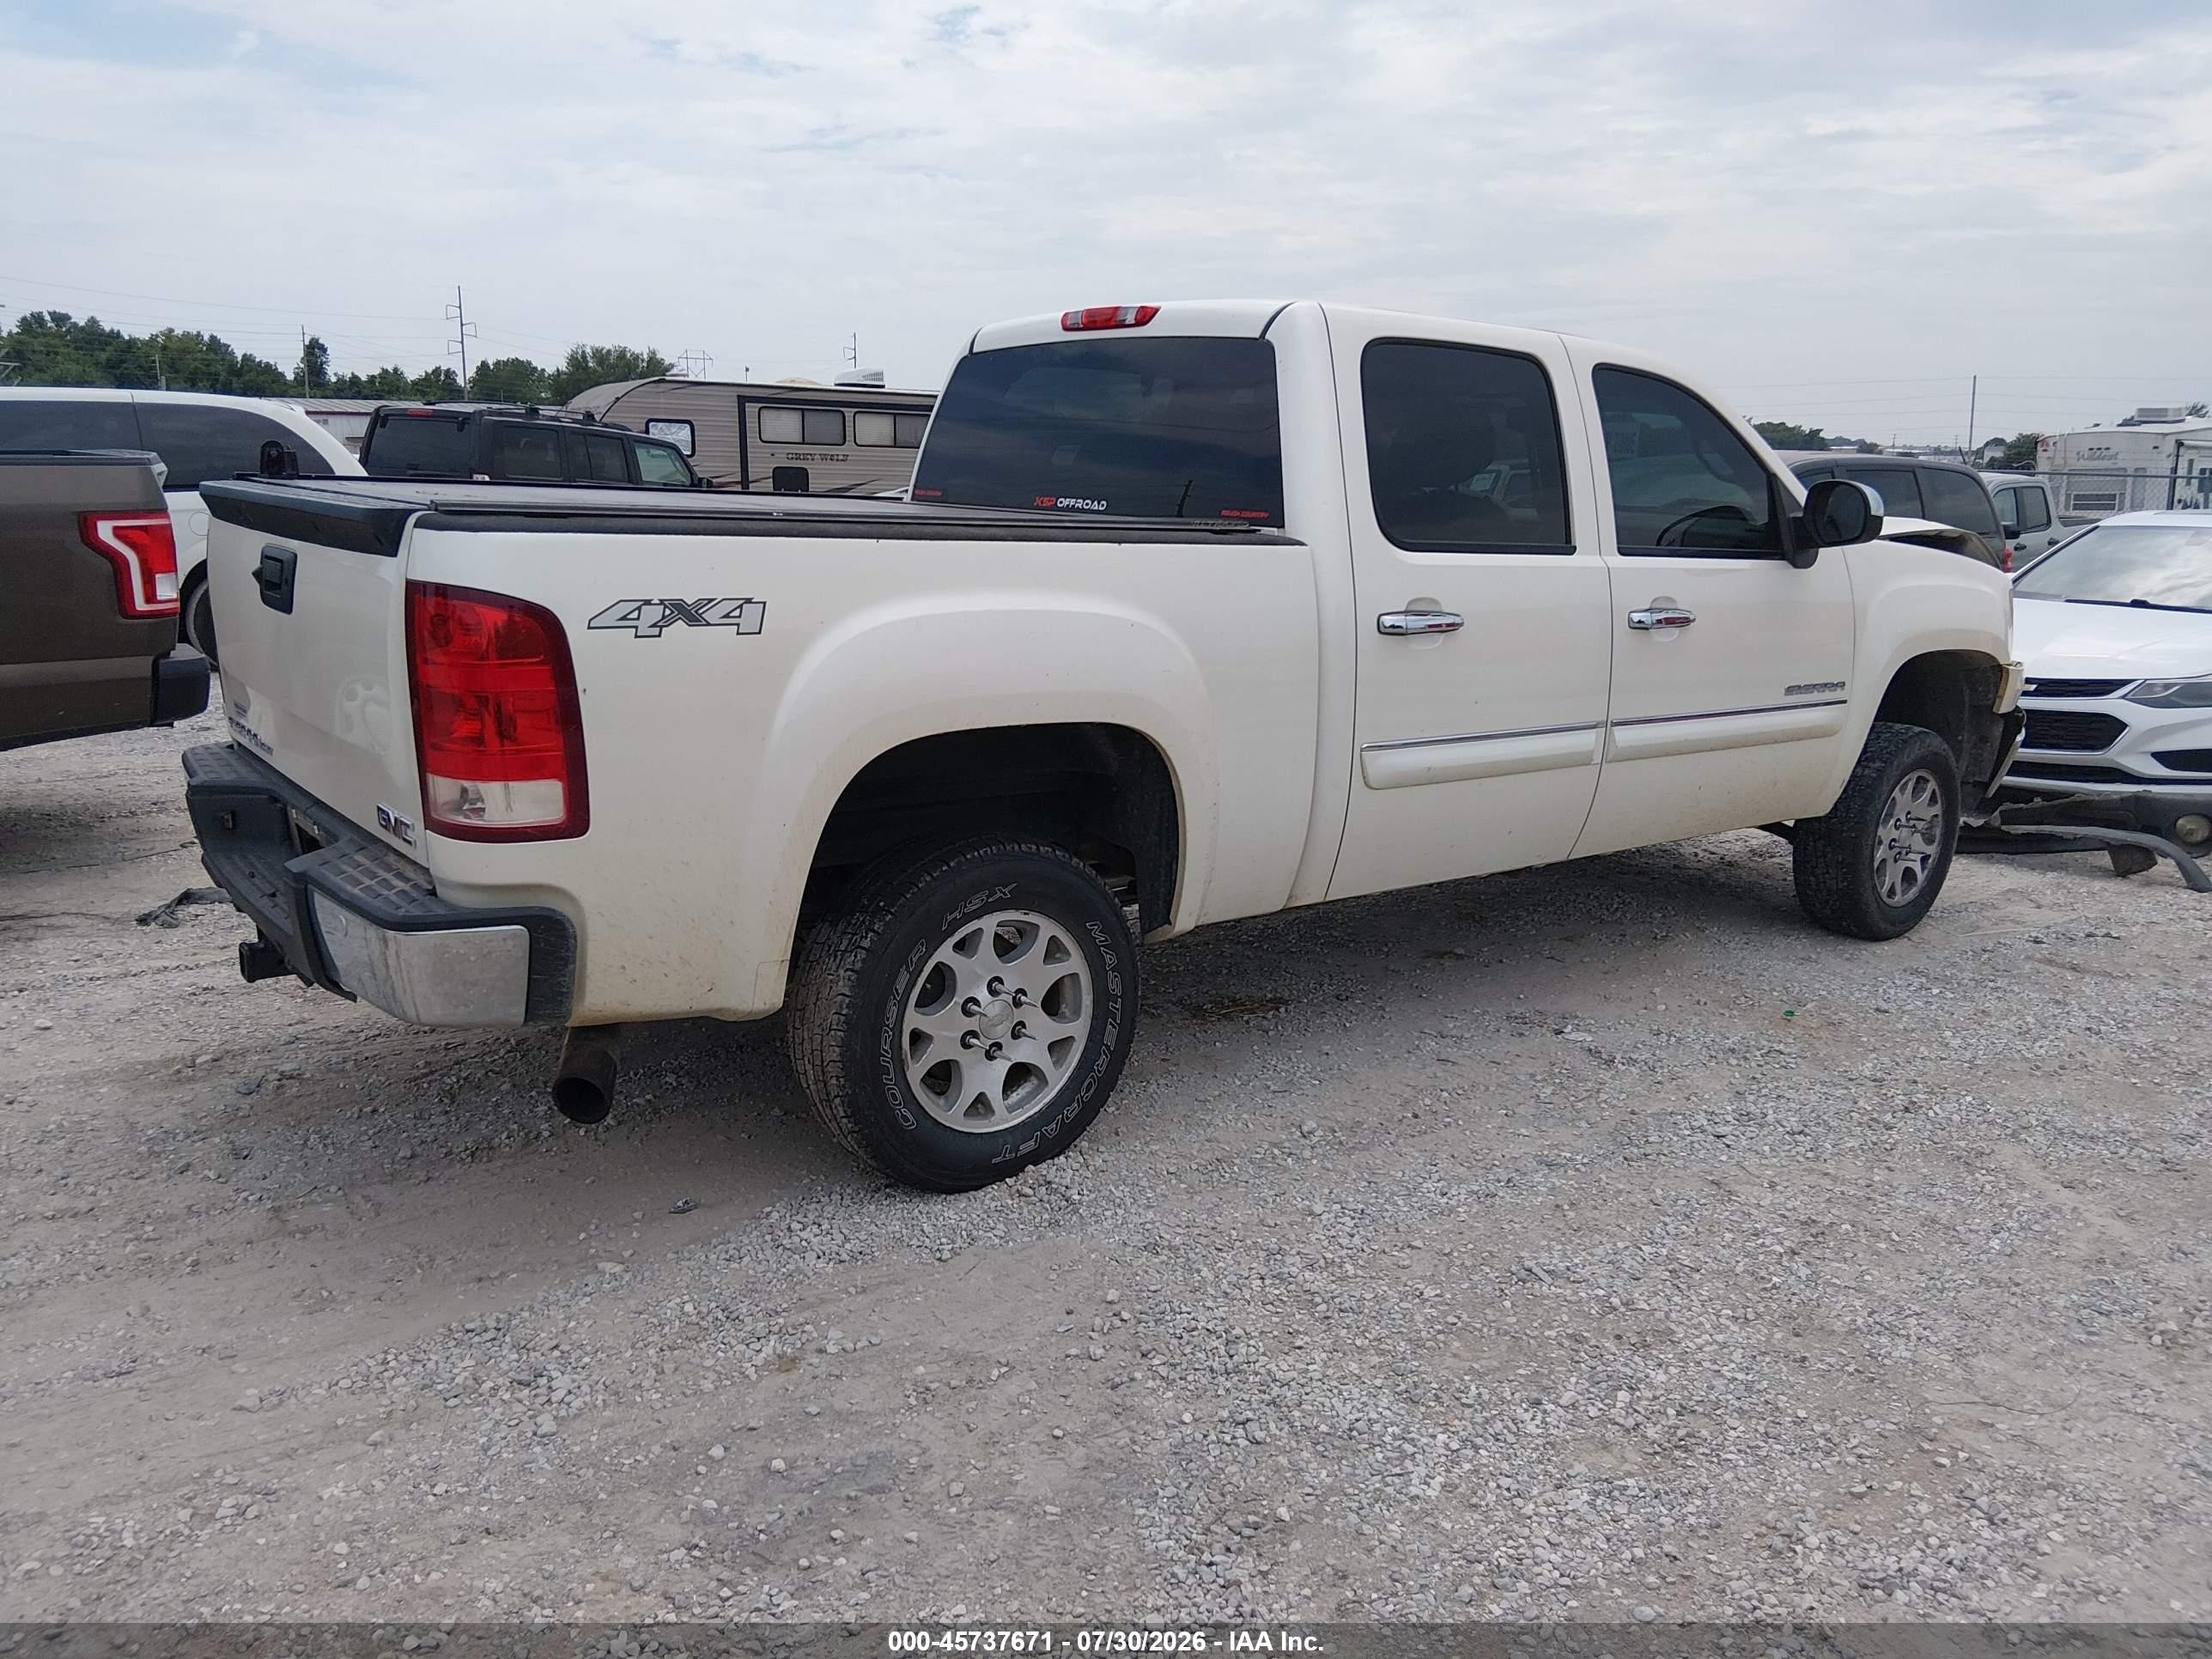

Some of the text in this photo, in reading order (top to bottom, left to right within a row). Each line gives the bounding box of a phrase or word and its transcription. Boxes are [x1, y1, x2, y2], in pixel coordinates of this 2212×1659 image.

[786, 453, 849, 462] GREY WOLF
[2075, 450, 2118, 463] Wildcat
[1056, 497, 1107, 510] OFFROAD
[1784, 681, 1845, 696] SIERRA
[376, 803, 416, 849] GMC
[878, 883, 1018, 1130] COURSER HSX
[991, 921, 1123, 1164] MASTERCRAFT
